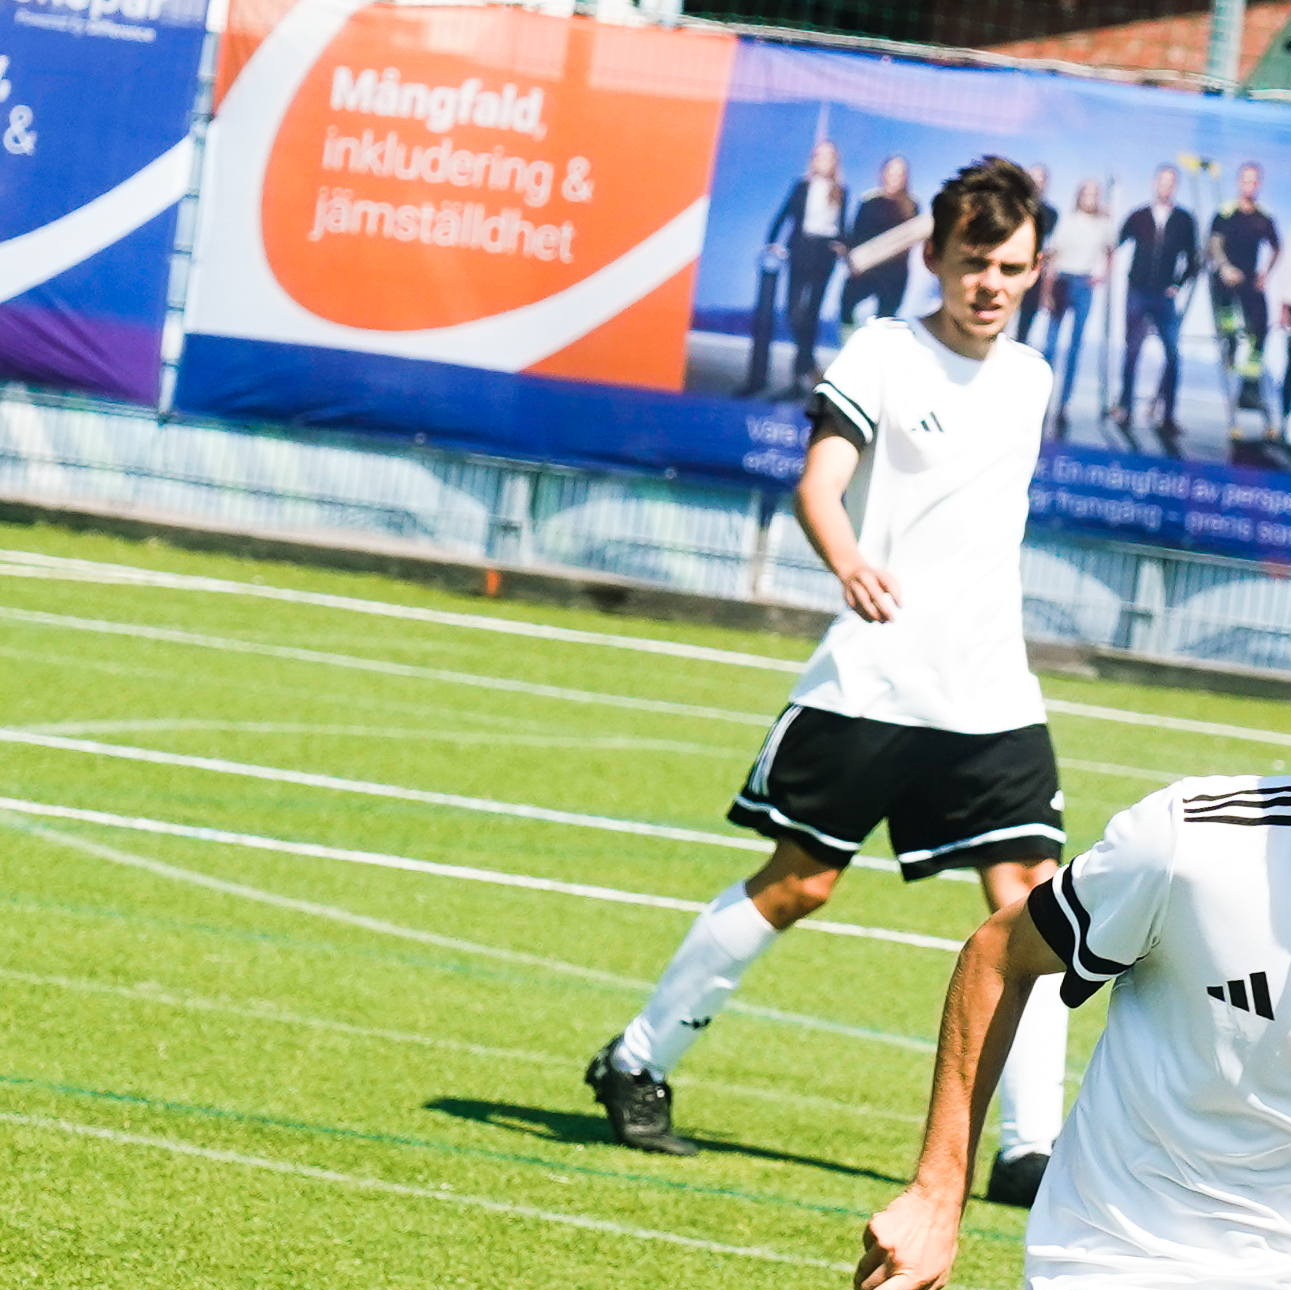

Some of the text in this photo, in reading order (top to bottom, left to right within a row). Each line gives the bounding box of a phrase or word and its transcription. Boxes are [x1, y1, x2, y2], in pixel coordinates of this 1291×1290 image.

[330, 65, 547, 141] Mångfald,
[322, 125, 595, 208] inkludering &
[309, 186, 576, 263] jämställdhet
